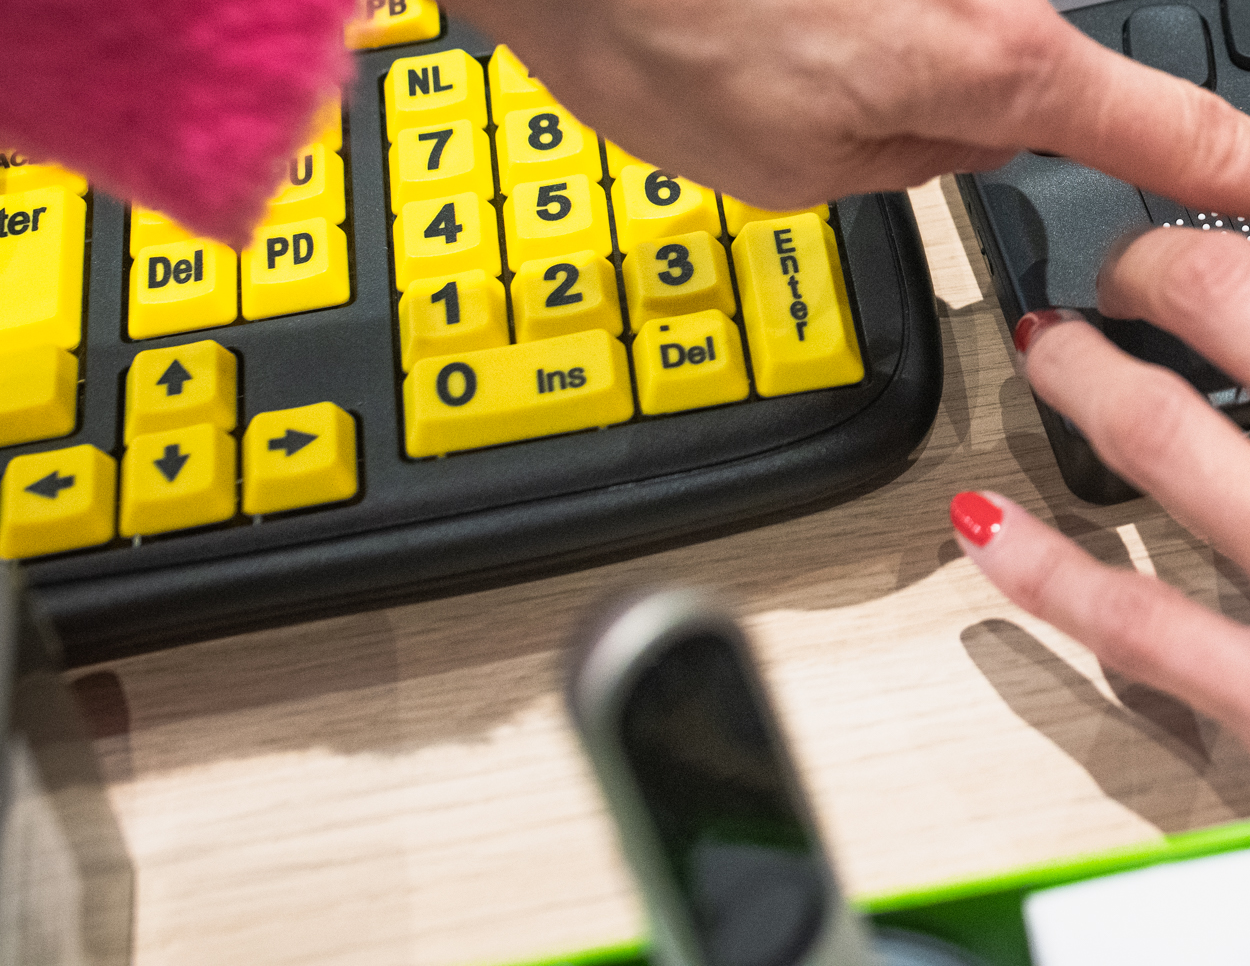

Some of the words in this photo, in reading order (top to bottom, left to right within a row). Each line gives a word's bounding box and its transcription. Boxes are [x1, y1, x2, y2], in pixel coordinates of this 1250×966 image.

[407, 65, 453, 97] NL
[417, 129, 454, 171] 7
[527, 112, 564, 151] 8
[535, 182, 572, 222] 5
[643, 170, 682, 207] 6
[0, 206, 48, 238] ter
[423, 203, 463, 245] 4
[147, 249, 204, 289] Del
[266, 232, 315, 270] PD
[655, 244, 695, 286] 3
[430, 281, 461, 325] 1
[544, 263, 583, 307] 2
[772, 227, 808, 342] Enter
[659, 336, 717, 369] Del
[436, 362, 477, 406] 0
[535, 366, 588, 396] Ins
